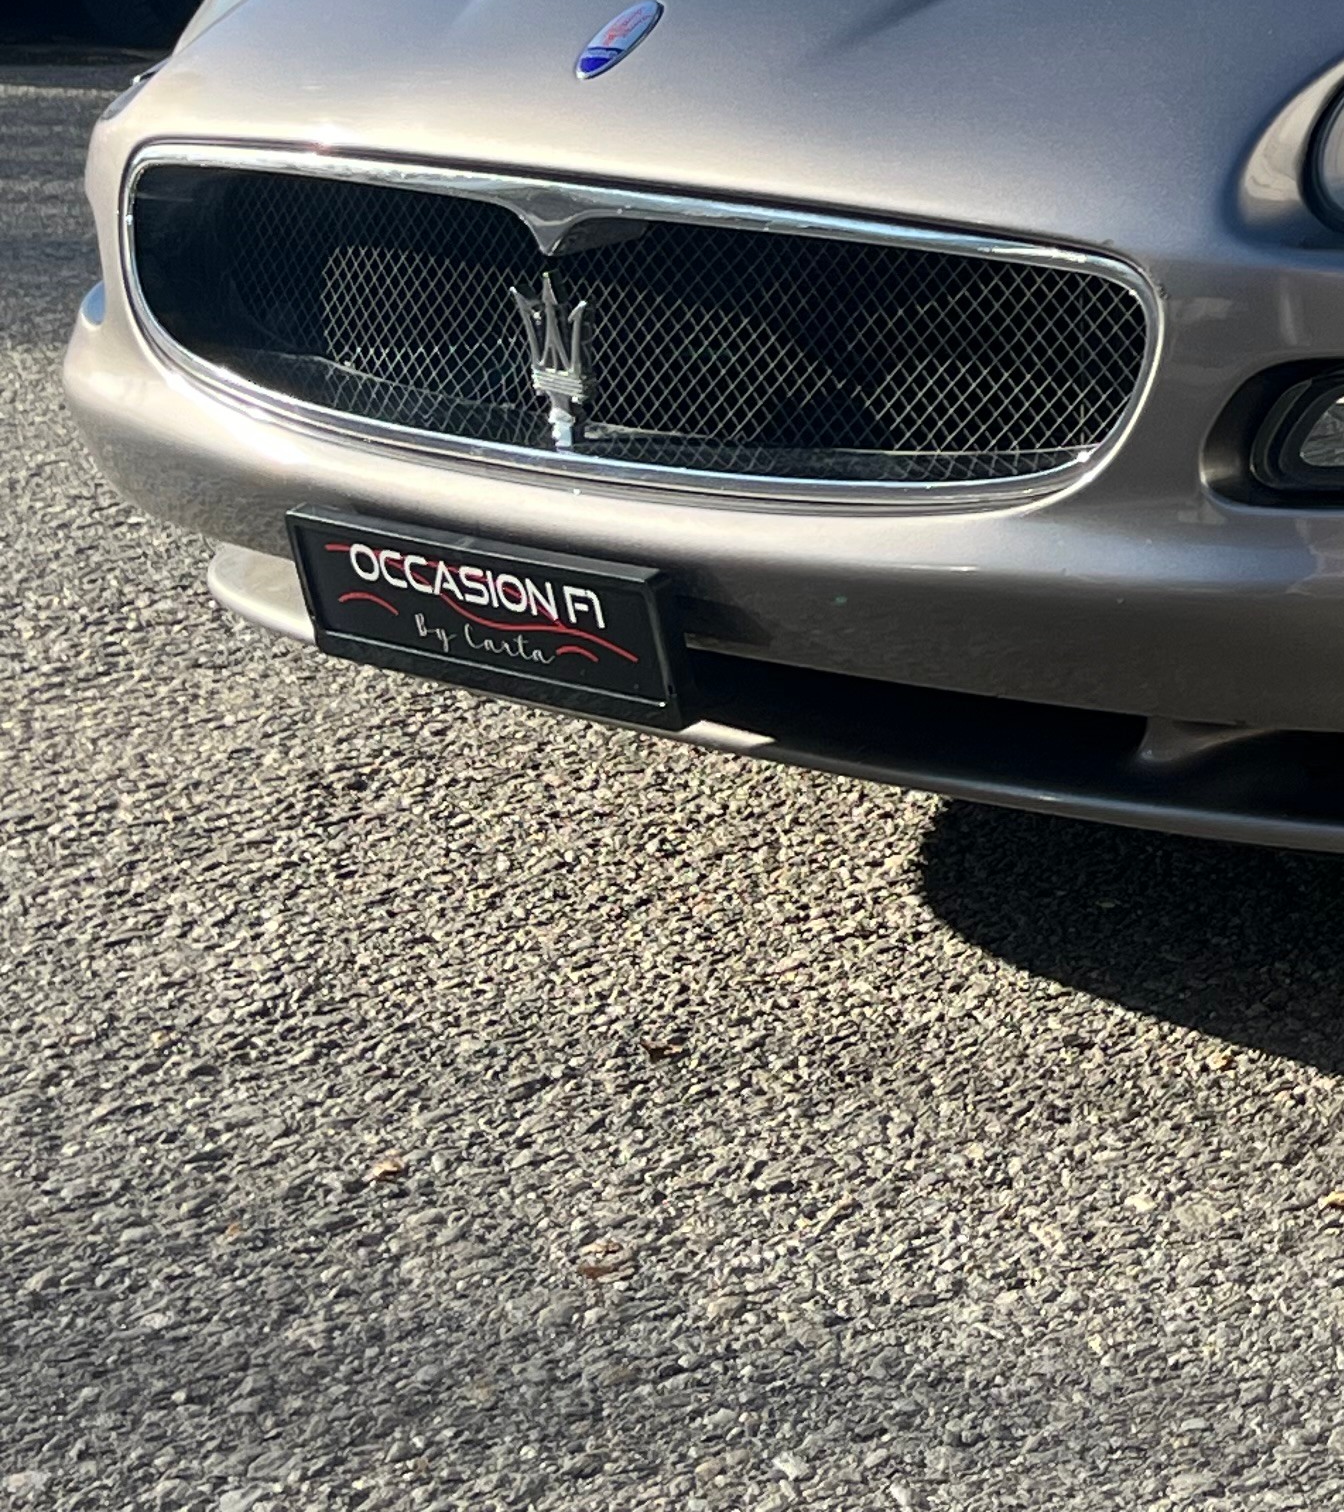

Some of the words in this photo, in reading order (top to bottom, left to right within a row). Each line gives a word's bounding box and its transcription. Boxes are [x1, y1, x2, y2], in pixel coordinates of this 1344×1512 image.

[350, 542, 560, 624] OCCASION
[562, 584, 606, 629] F1
[414, 612, 456, 652] By
